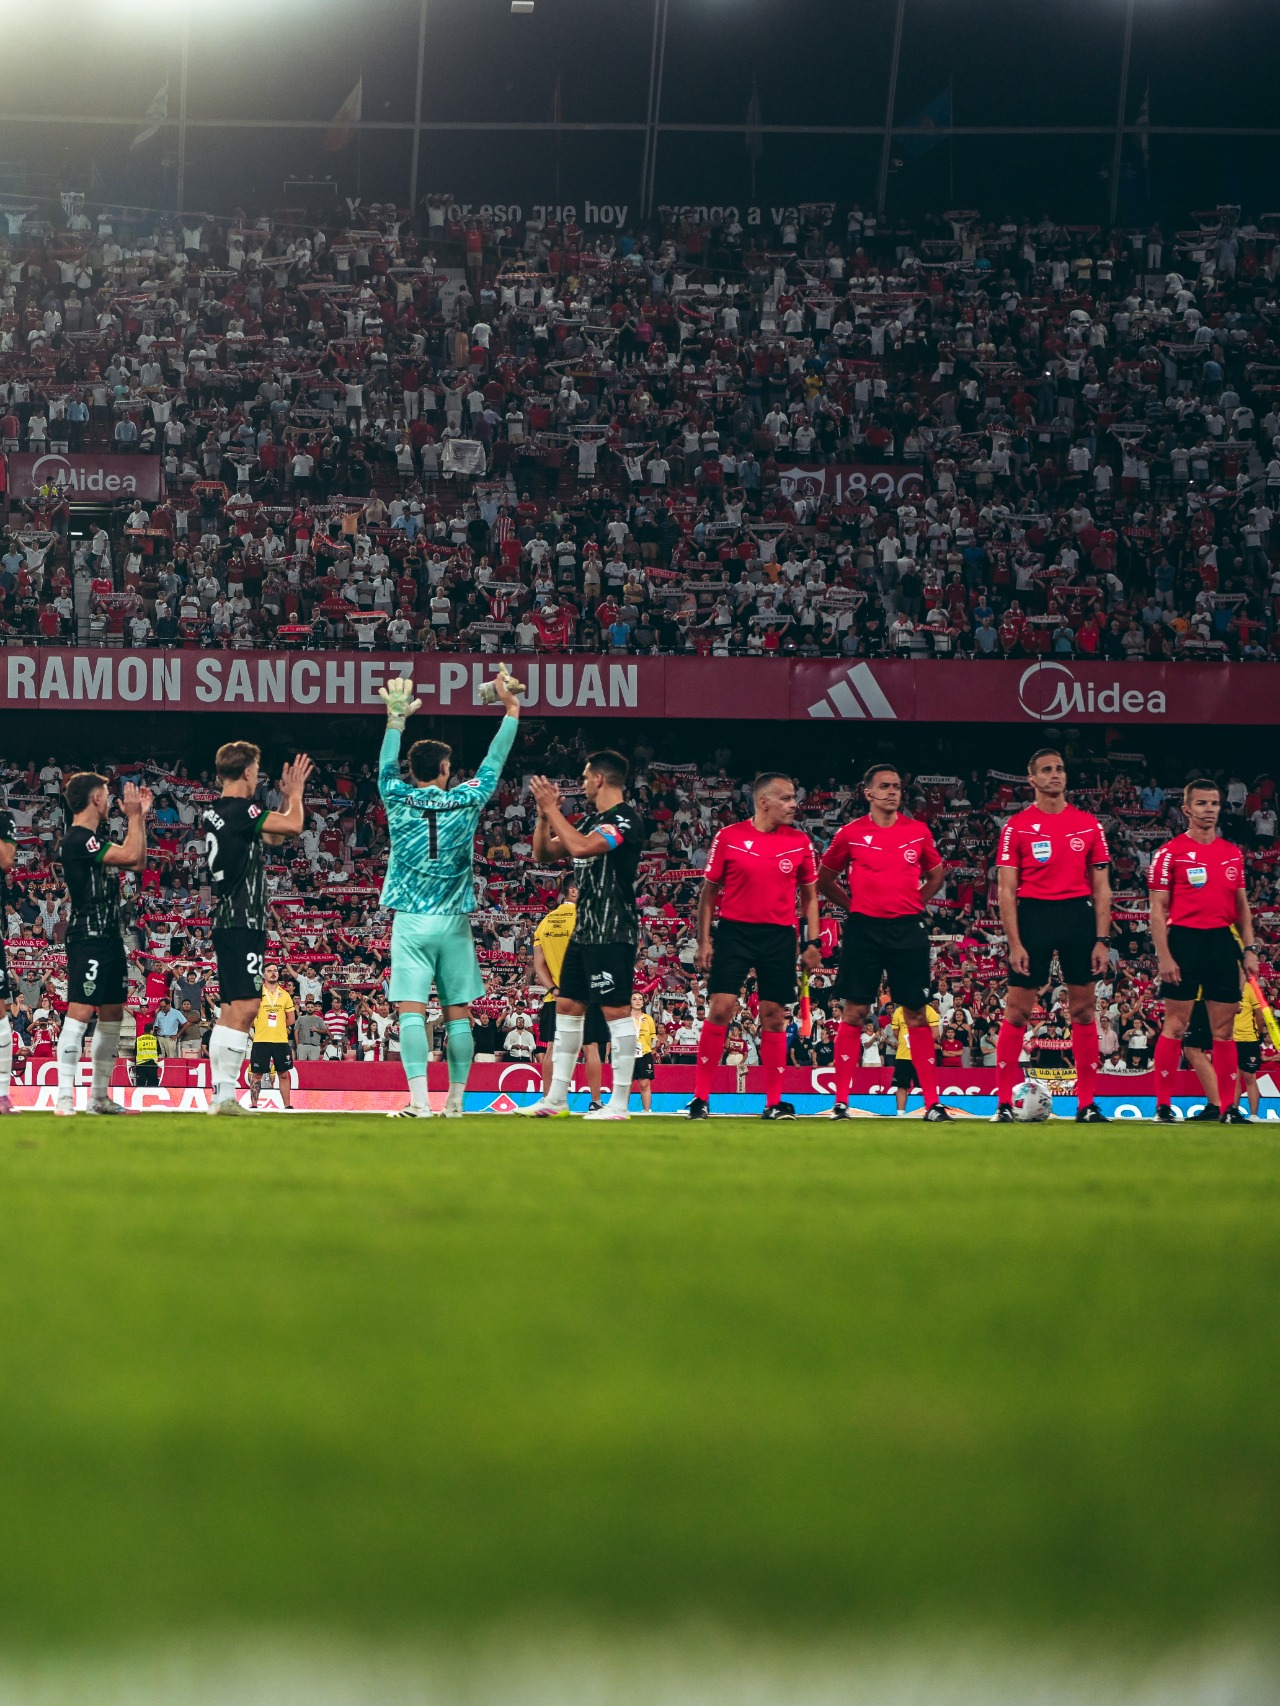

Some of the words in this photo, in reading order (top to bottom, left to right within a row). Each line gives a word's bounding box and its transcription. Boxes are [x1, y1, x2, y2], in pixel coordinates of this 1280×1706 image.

[447, 204, 472, 219] or
[479, 204, 521, 222] eso
[532, 205, 576, 226] que
[585, 201, 628, 229] hoy
[748, 206, 762, 225] a
[771, 207, 835, 227] vere
[42, 460, 136, 492] Midea
[7, 656, 182, 701] RAMON
[1028, 669, 1166, 717] Midea
[421, 811, 439, 862] 1
[47, 955, 68, 964] SEVILL
[488, 949, 508, 959] 1890
[85, 959, 99, 981] 3
[472, 999, 507, 1007] CAMPEON
